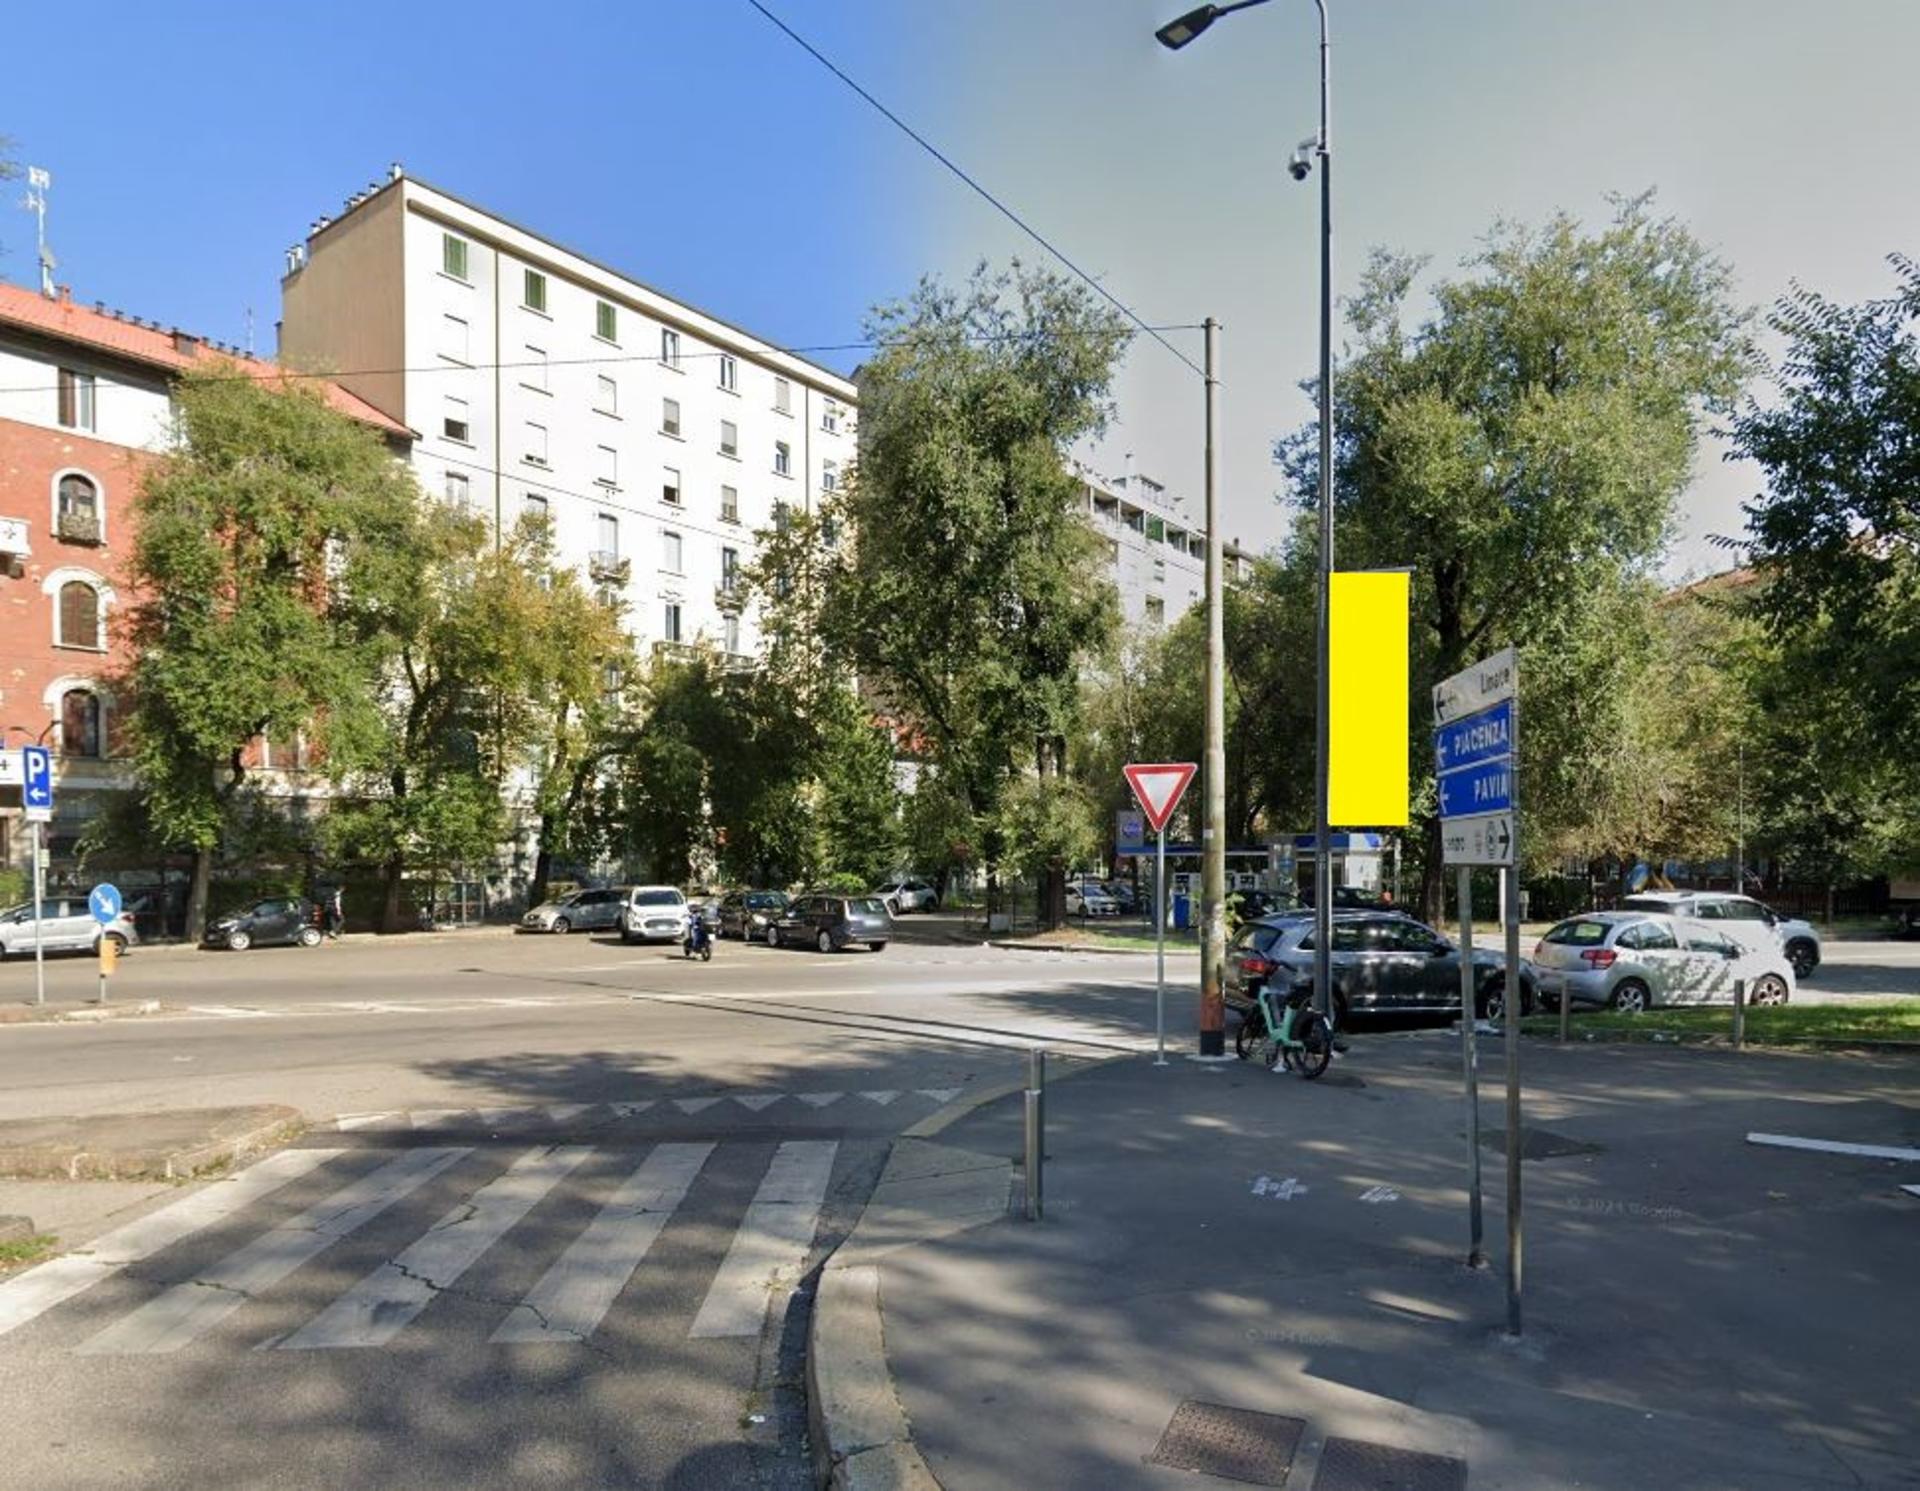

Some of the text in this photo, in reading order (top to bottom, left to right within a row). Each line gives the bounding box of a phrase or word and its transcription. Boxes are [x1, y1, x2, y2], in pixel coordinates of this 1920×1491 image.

[1454, 718, 1509, 756] PIACENZA
[27, 751, 45, 784] P
[1473, 773, 1509, 803] PAVIA
